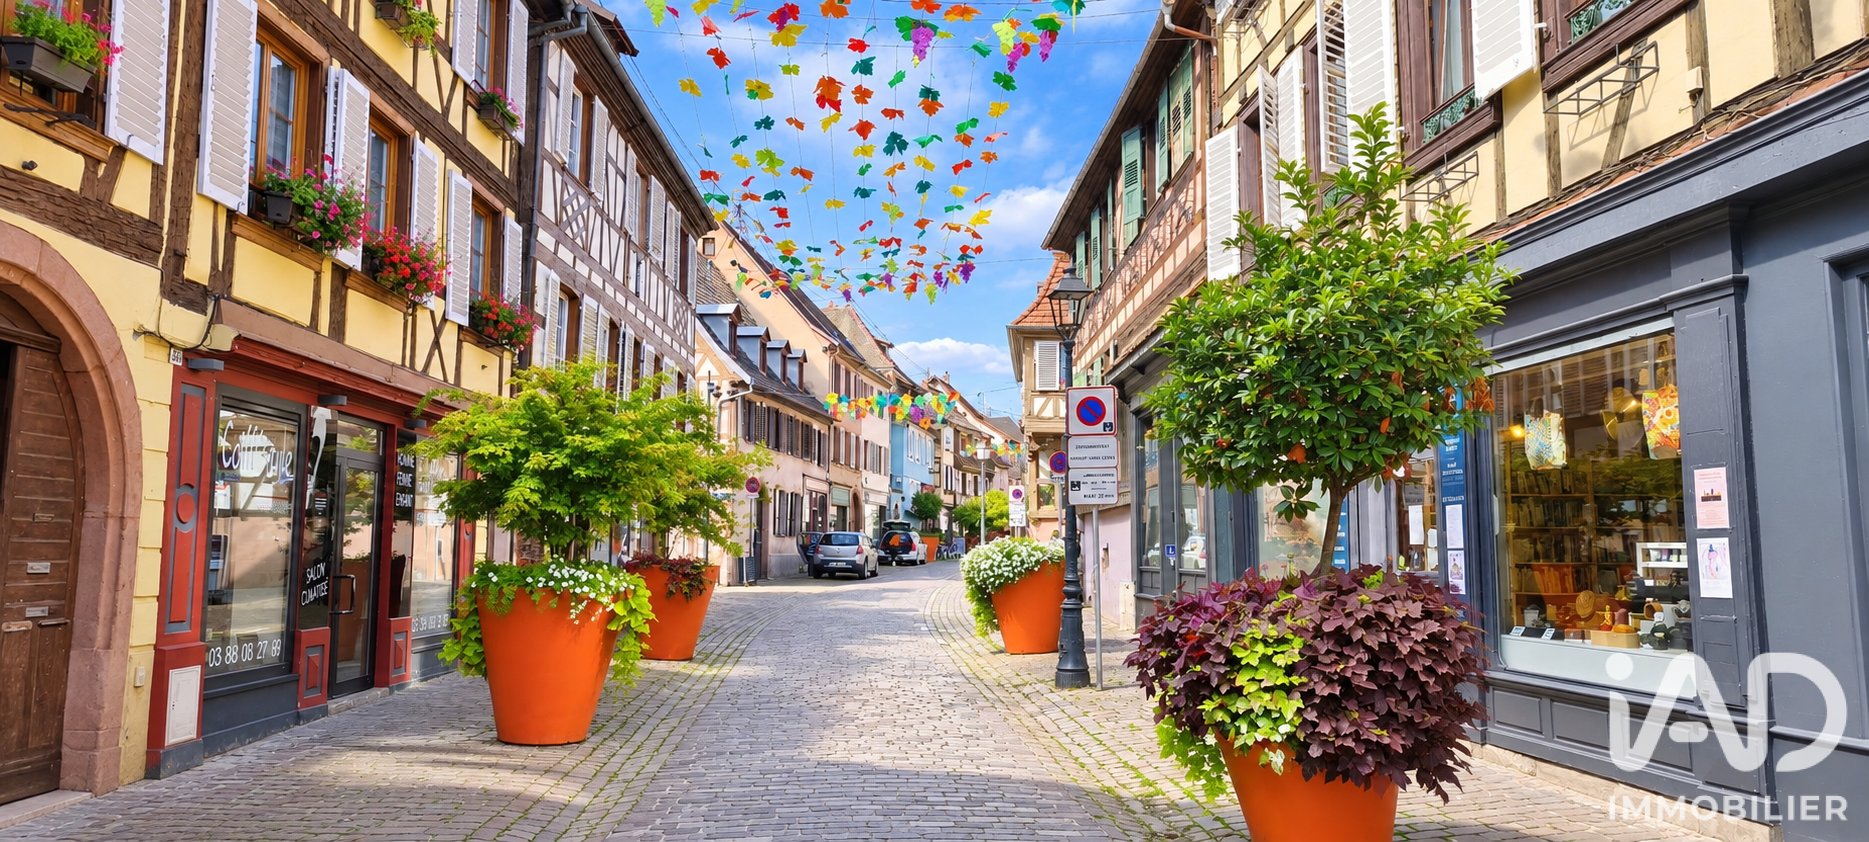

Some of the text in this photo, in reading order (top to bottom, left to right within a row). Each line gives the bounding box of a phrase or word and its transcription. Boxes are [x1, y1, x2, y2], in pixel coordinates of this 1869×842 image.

[306, 562, 326, 584] SALON
[208, 638, 282, 668] 03 88 08 27 89
